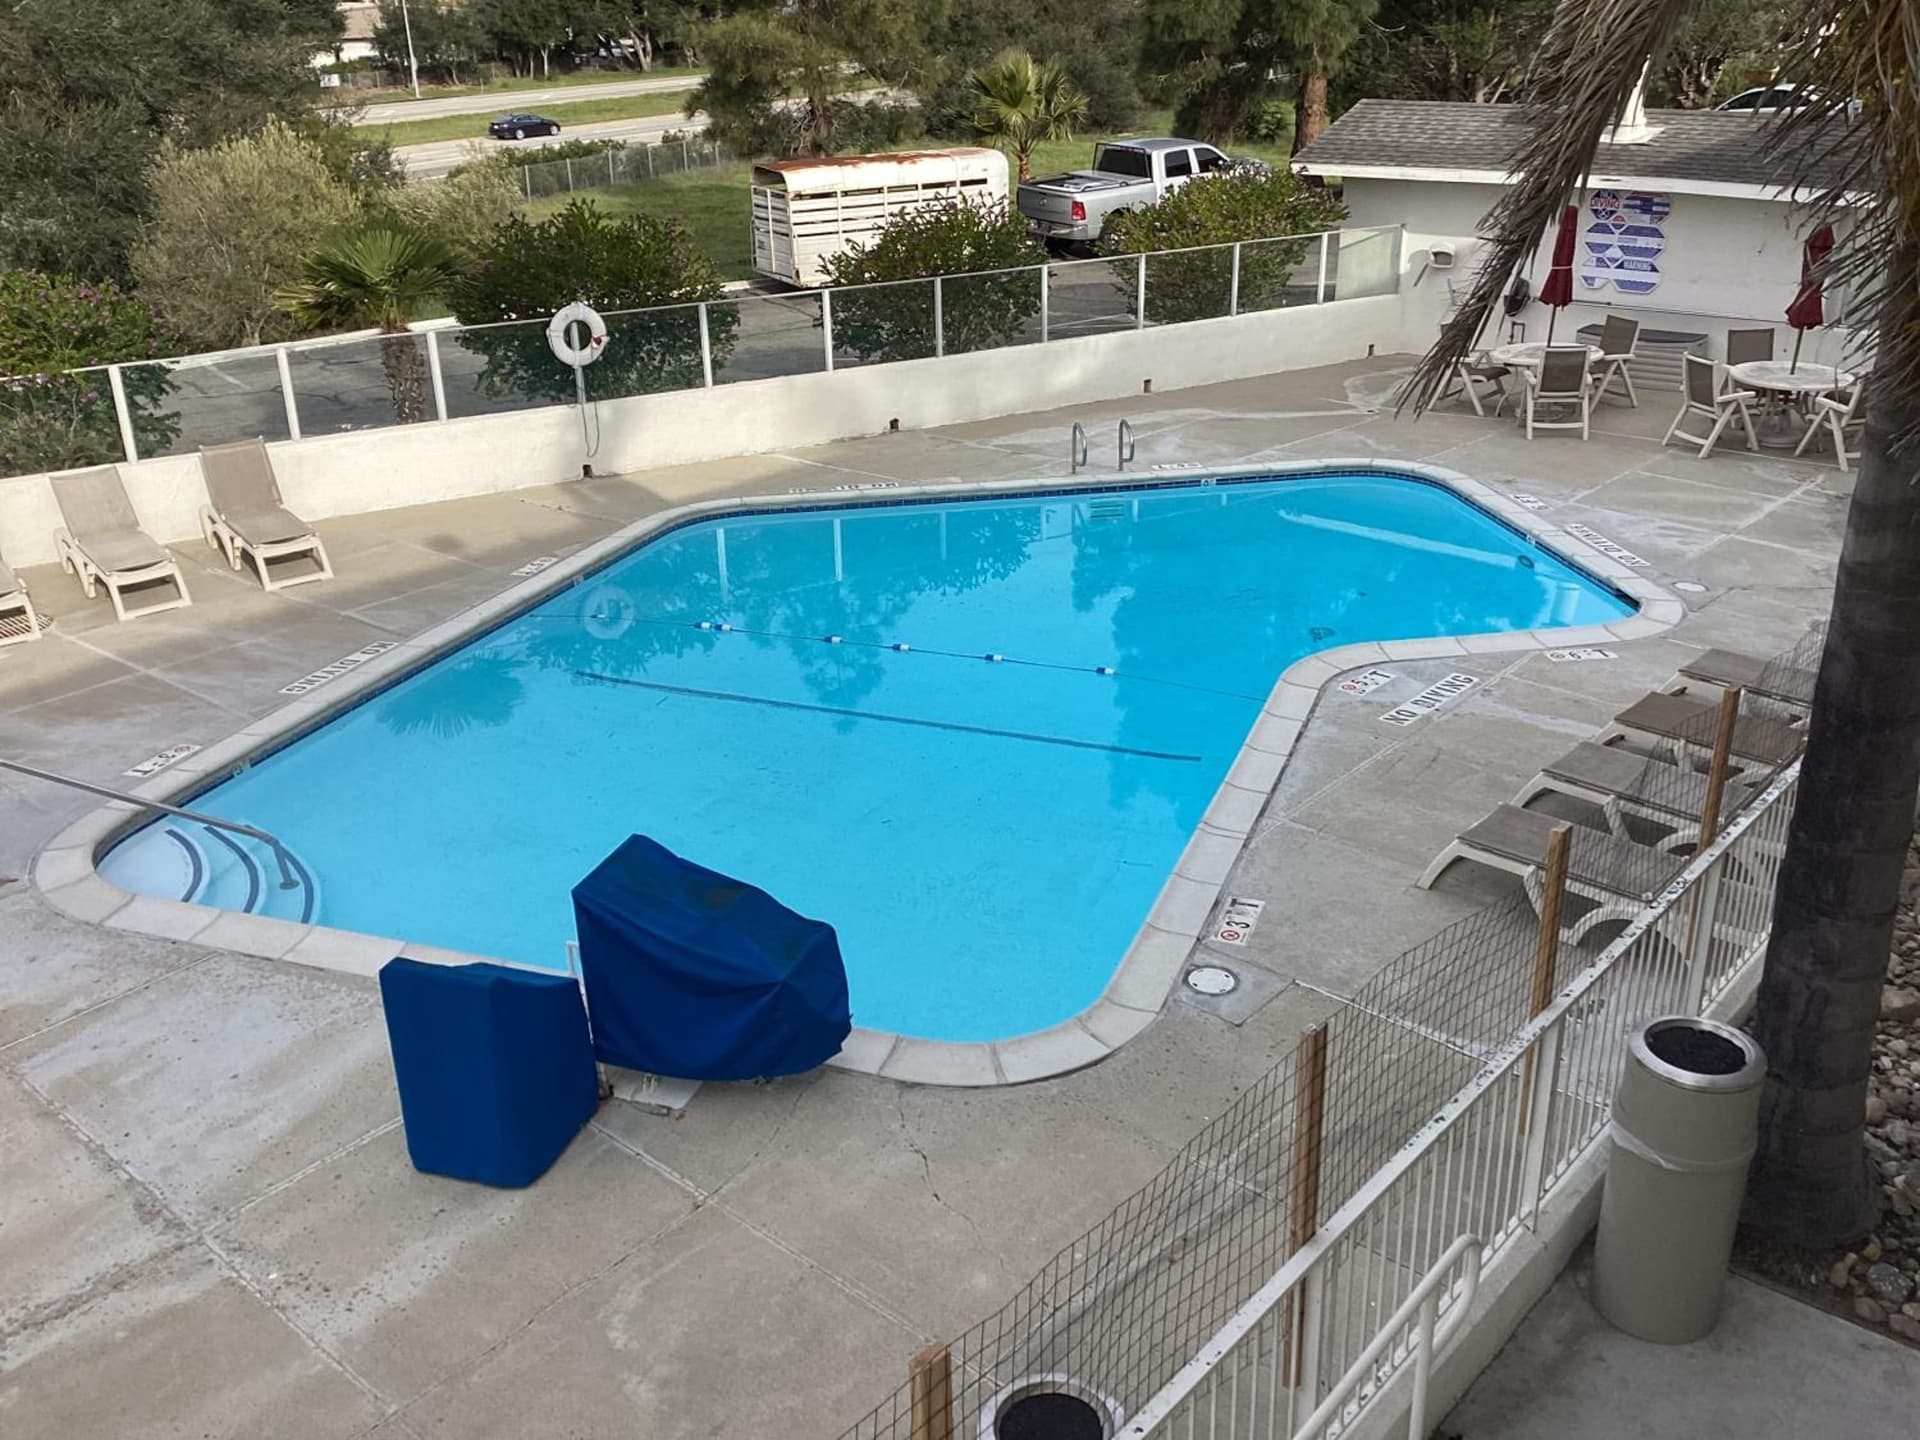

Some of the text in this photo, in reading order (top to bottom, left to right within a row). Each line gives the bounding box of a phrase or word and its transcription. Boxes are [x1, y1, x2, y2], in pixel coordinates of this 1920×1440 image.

[1591, 198, 1620, 209] DIVING
[1570, 524, 1623, 553] DIVING
[285, 640, 394, 692] NO DIVING
[1382, 674, 1474, 725] NO DIVING
[1225, 920, 1250, 929] 3
